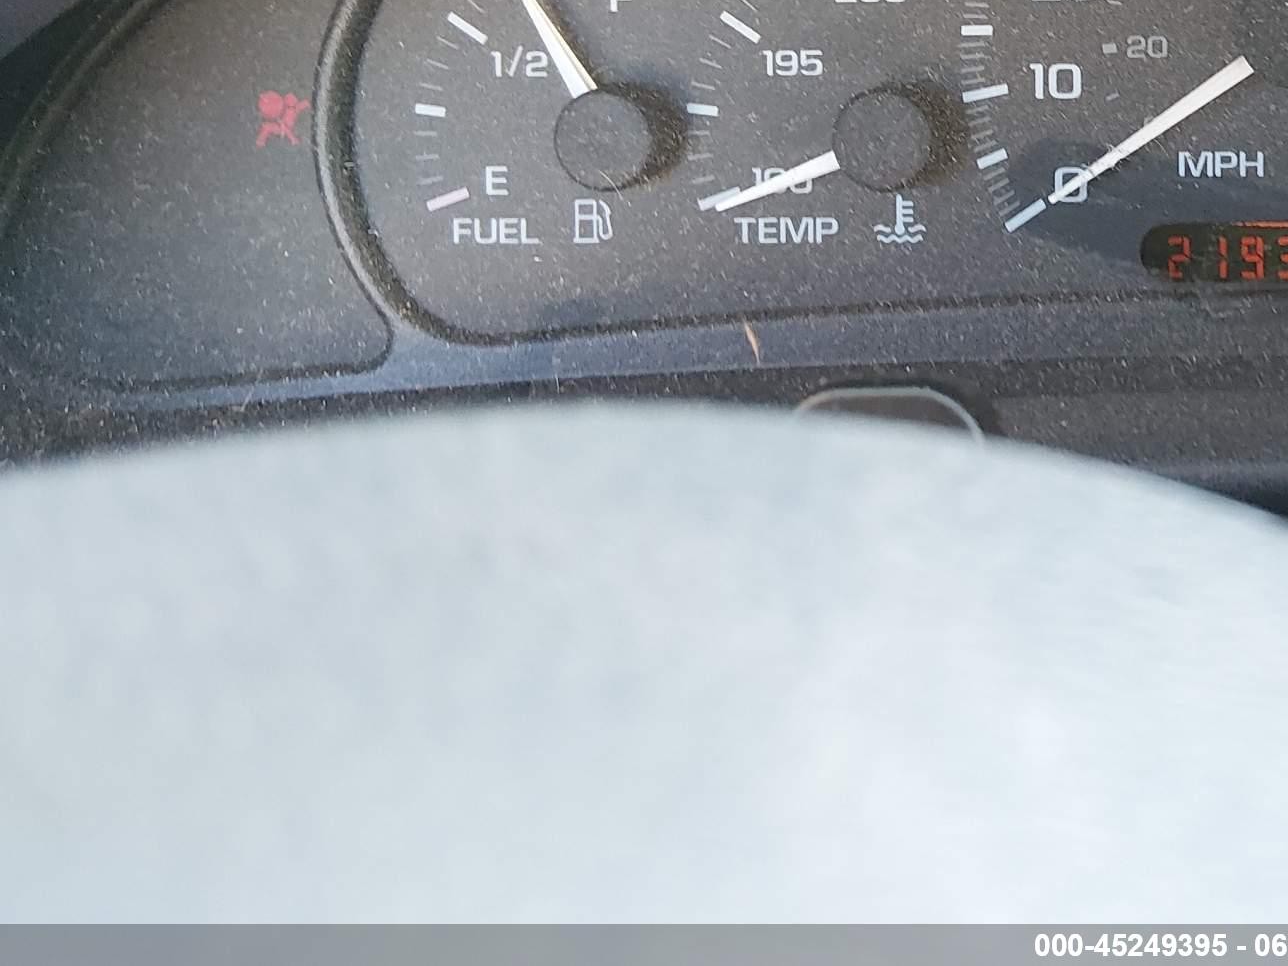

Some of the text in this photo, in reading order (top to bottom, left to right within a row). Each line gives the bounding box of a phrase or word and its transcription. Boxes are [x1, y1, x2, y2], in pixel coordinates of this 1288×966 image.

[1126, 36, 1168, 58] 20
[493, 46, 548, 77] 1/2
[763, 50, 823, 75] 195
[1030, 64, 1081, 100] 10
[1178, 151, 1264, 178] MPH
[486, 166, 508, 195] E
[1055, 167, 1088, 203] 0
[453, 218, 539, 244] FUEL
[733, 216, 839, 244] TEMP
